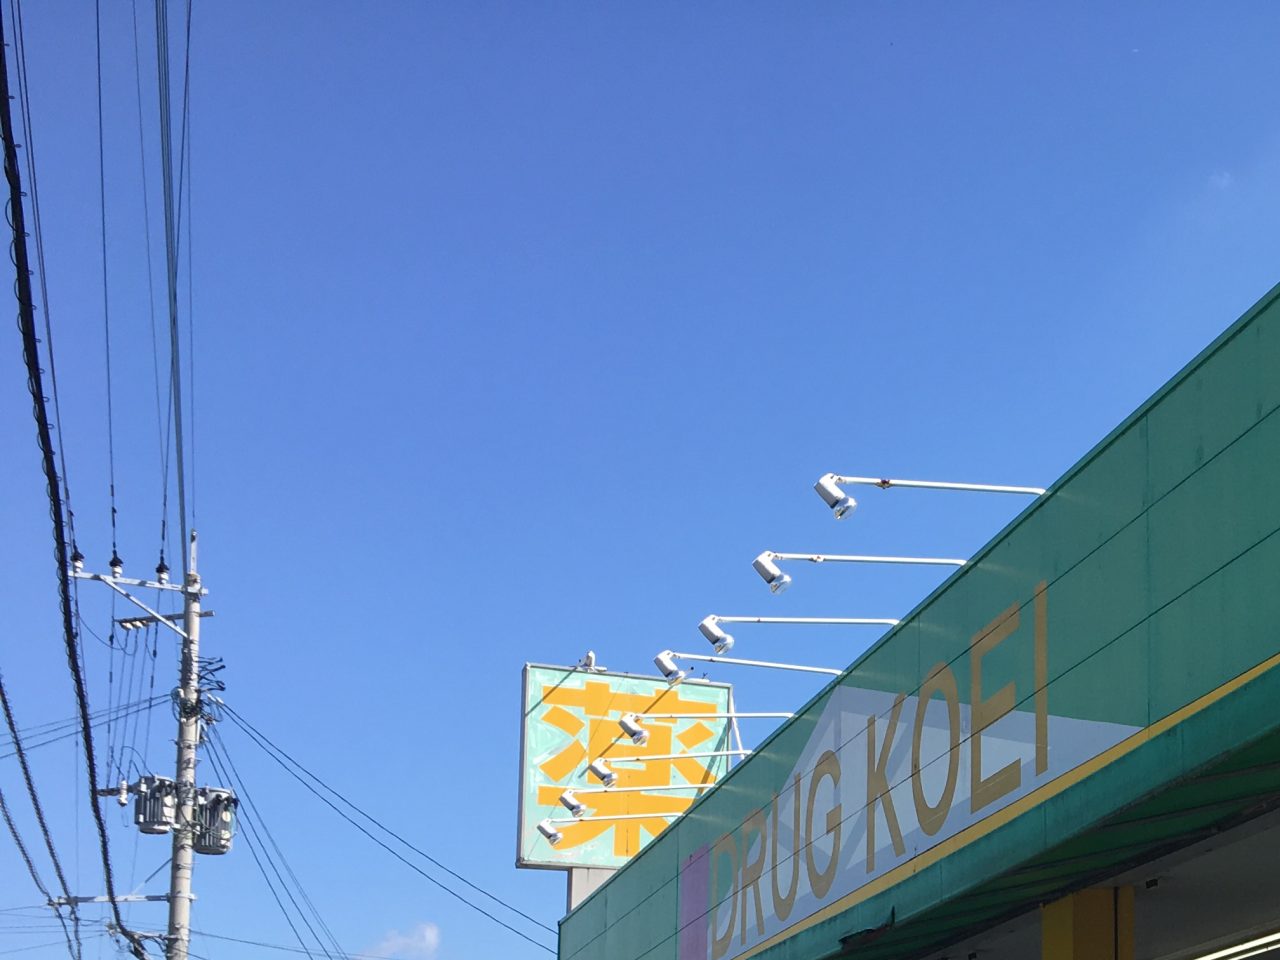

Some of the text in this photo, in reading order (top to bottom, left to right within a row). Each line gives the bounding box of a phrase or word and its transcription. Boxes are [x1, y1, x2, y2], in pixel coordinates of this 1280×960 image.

[537, 681, 718, 857] 薬
[709, 580, 1049, 960] DRUG KOEI
